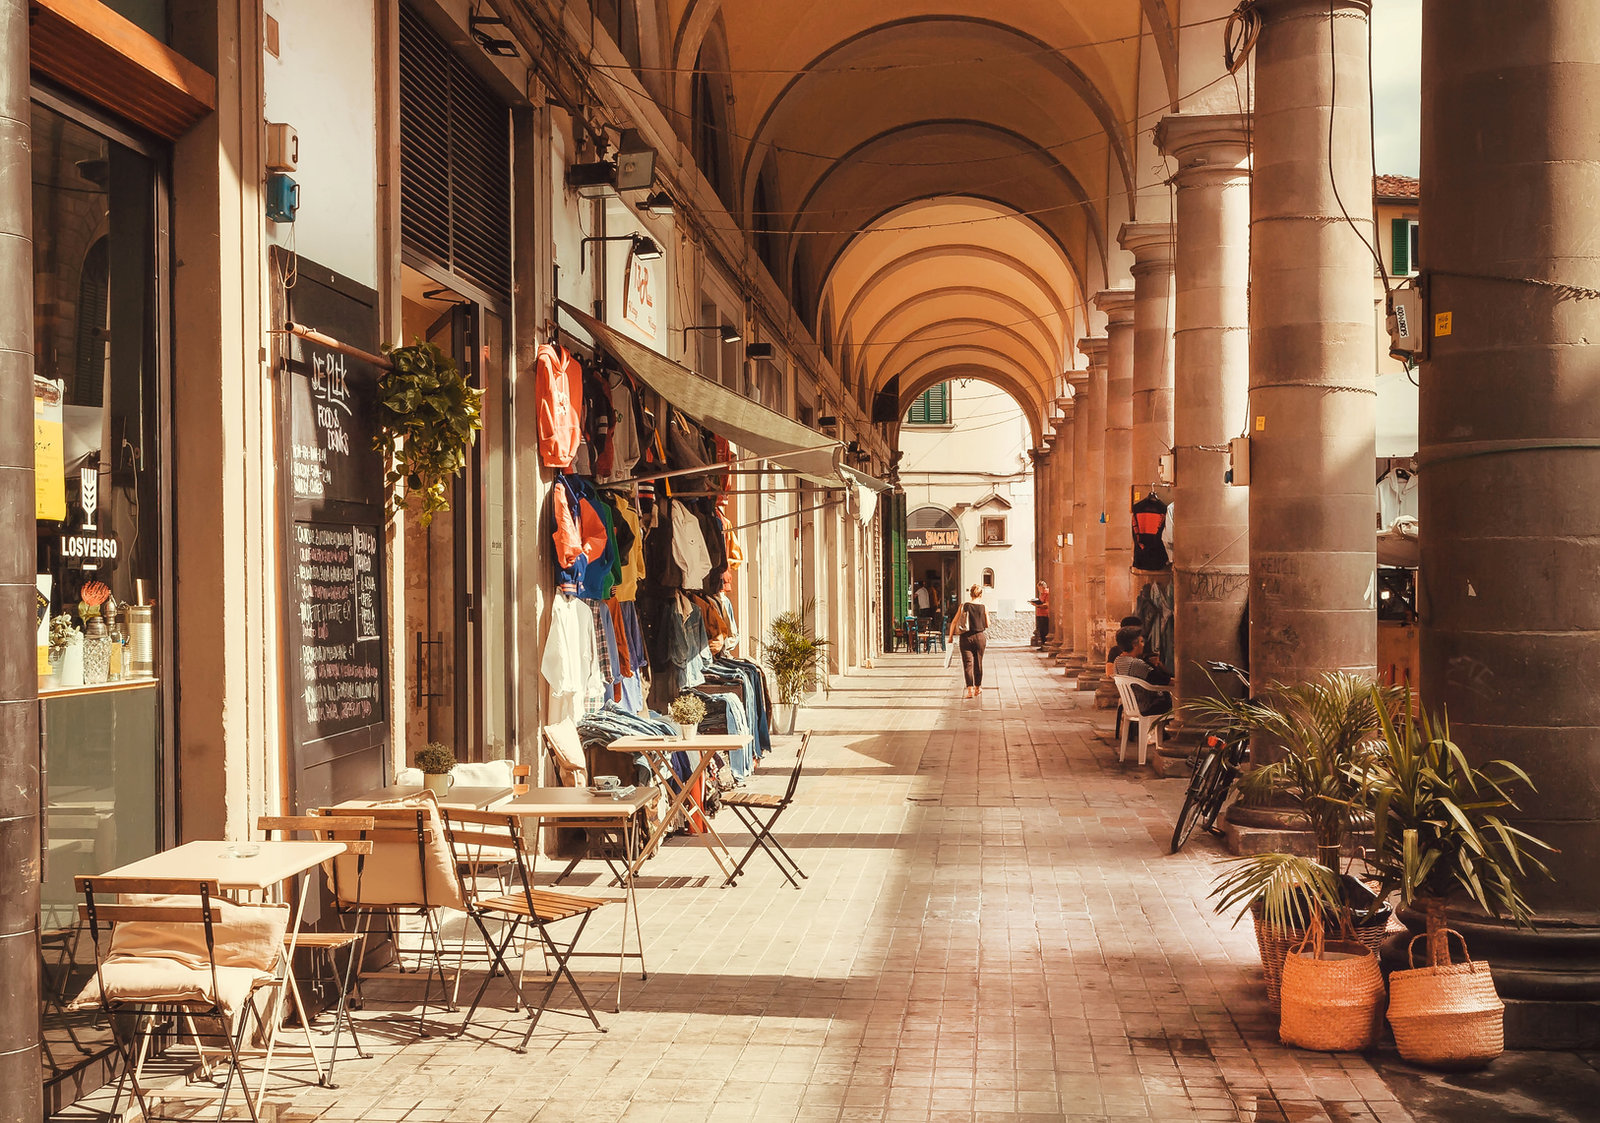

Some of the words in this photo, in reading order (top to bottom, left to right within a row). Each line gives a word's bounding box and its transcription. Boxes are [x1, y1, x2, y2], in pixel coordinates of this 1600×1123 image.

[312, 352, 327, 390] DE
[61, 536, 117, 559] LOSVERSO
[925, 530, 946, 546] SNACK
[946, 530, 959, 546] BAR
